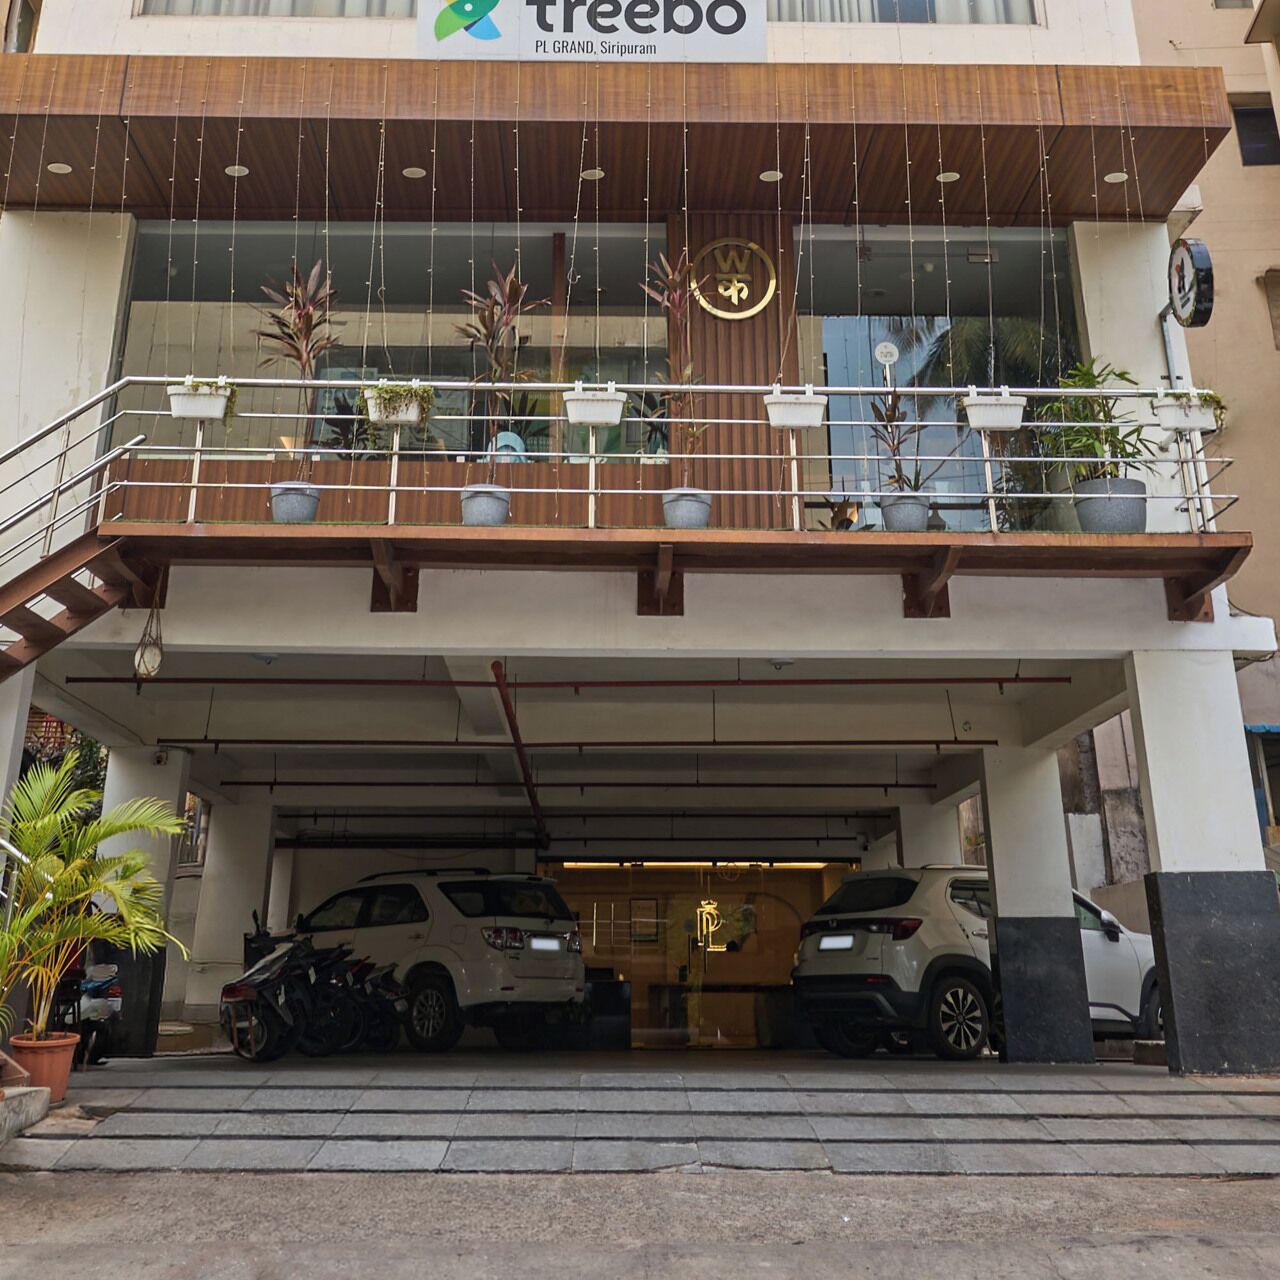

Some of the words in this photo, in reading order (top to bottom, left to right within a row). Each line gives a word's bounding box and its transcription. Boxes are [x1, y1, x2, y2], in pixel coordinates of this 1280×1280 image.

[535, 41, 550, 54] PL
[553, 41, 596, 56] GRAND,
[600, 40, 657, 58] Siripuram
